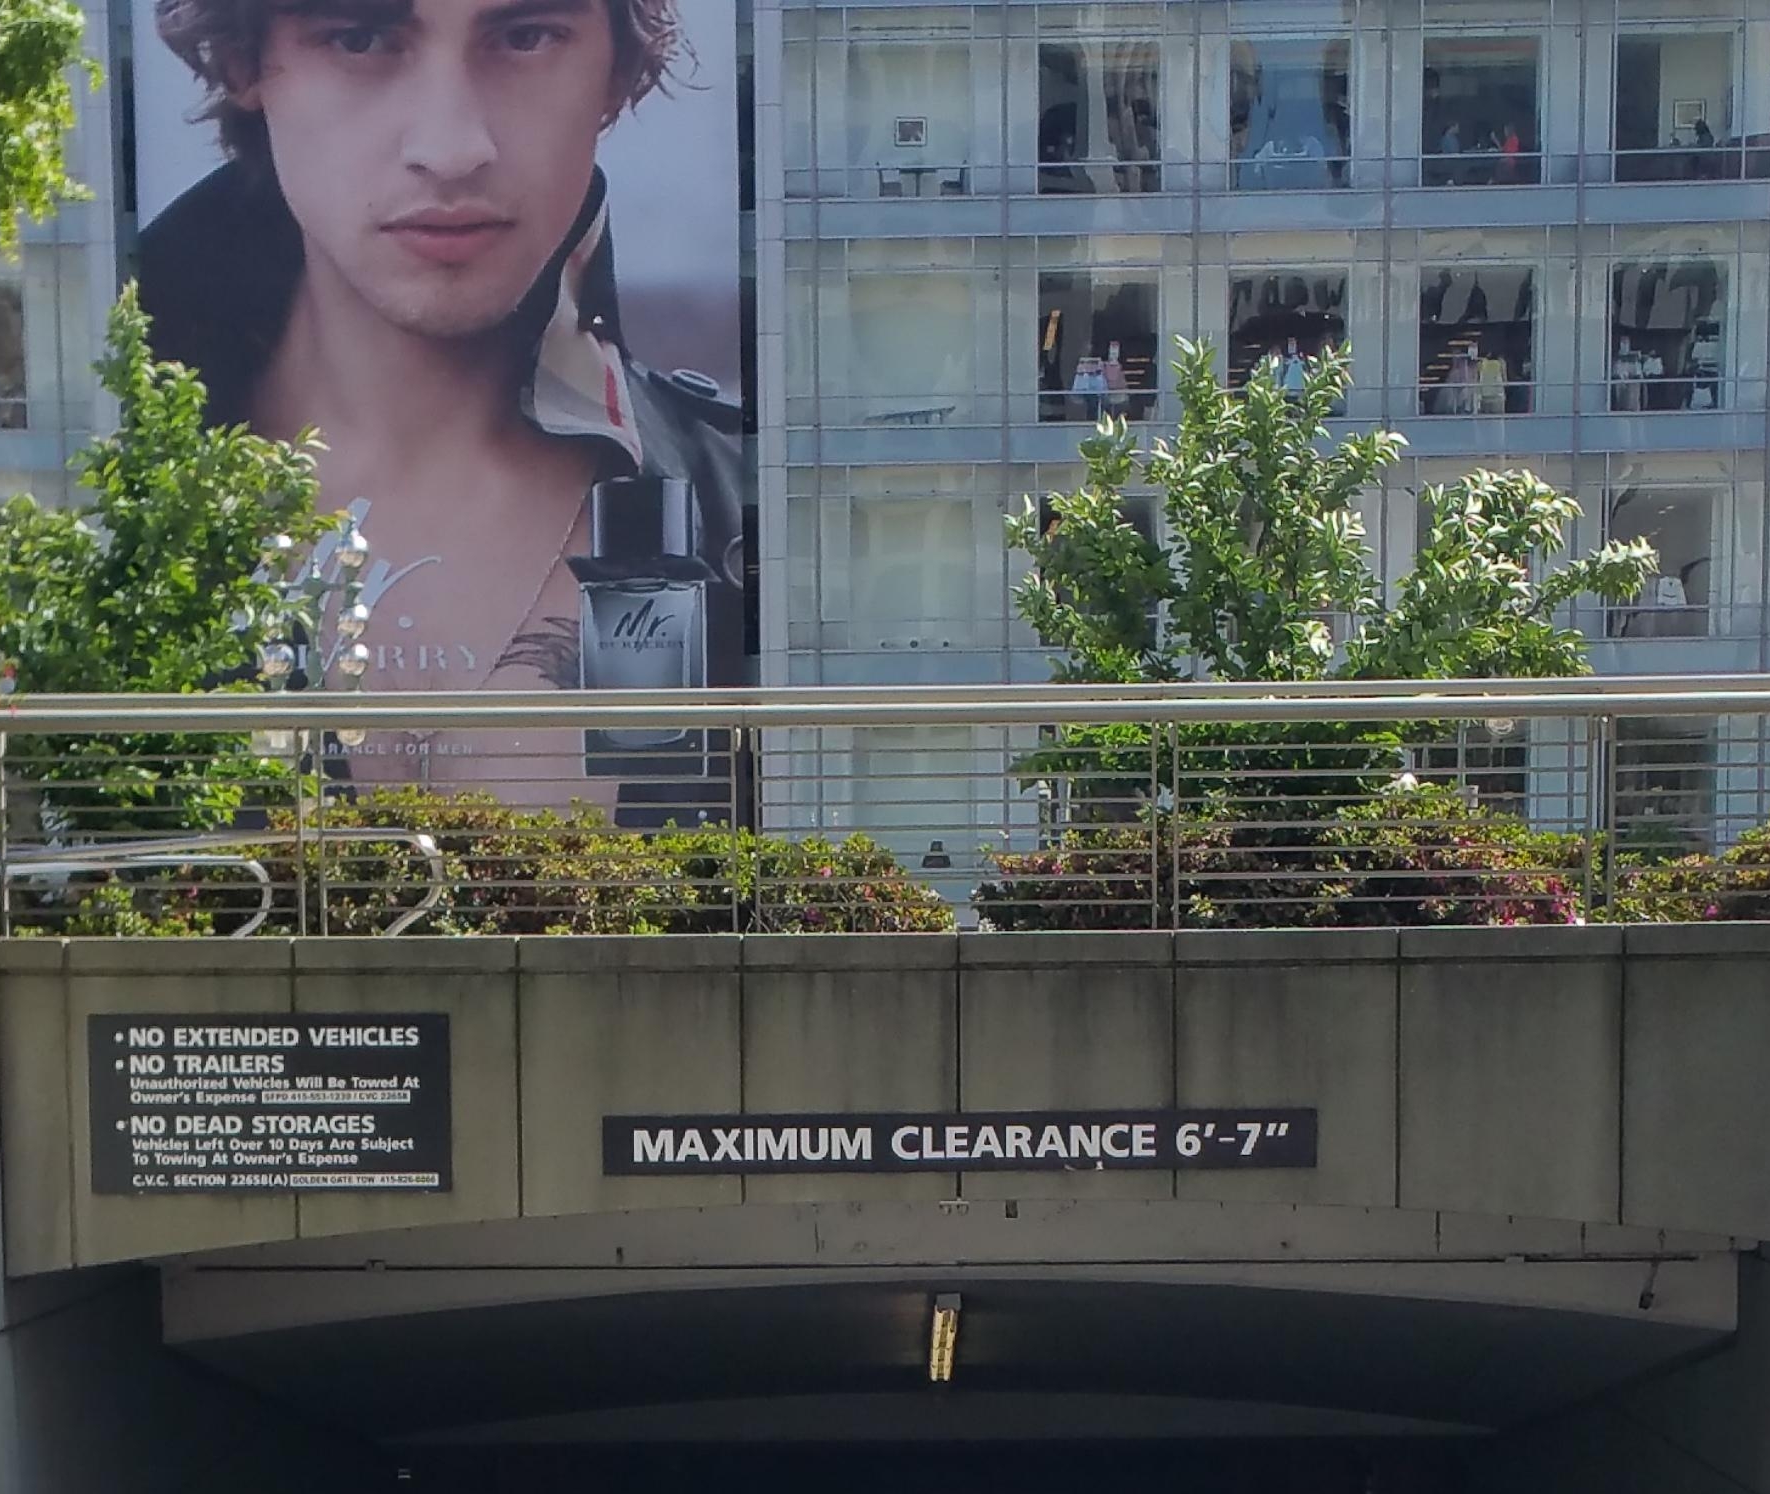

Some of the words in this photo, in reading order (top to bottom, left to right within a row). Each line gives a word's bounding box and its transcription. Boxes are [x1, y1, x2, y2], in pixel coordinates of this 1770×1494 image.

[613, 598, 675, 653] Mr.
[436, 742, 473, 755] MEN
[129, 1027, 165, 1047] NO
[173, 1027, 299, 1047] EXTENDED
[308, 1026, 420, 1046] VEHICLES
[129, 1055, 166, 1074] NO
[173, 1054, 285, 1073] TRAILERS
[130, 1076, 227, 1090] Unauthorized
[232, 1076, 290, 1090] Vehicles
[294, 1076, 323, 1089] Will
[328, 1077, 346, 1089] Be
[350, 1076, 398, 1089] Towed
[402, 1076, 420, 1089] At
[130, 1091, 190, 1104] Owner's
[195, 1091, 257, 1106] Expense
[130, 1115, 166, 1135] NO
[176, 1115, 242, 1134] DEAD
[251, 1115, 376, 1134] STORAGES
[132, 1137, 189, 1151] Vehicles
[195, 1137, 224, 1151] Left
[229, 1137, 264, 1151] Over
[269, 1138, 285, 1150] 10
[289, 1138, 324, 1153] Days
[329, 1137, 355, 1150] Are
[360, 1137, 415, 1153] Subject
[632, 1127, 873, 1163] MAXIMUM
[891, 1123, 1157, 1161] CLEARANCE
[1175, 1121, 1290, 1157] 6'-7"
[132, 1152, 149, 1165] To
[154, 1152, 207, 1168] Towing
[211, 1152, 229, 1165] At
[233, 1152, 293, 1165] Owner's
[298, 1153, 359, 1167] Expense
[132, 1173, 169, 1187] C.V.C.
[173, 1173, 227, 1187] SECTION
